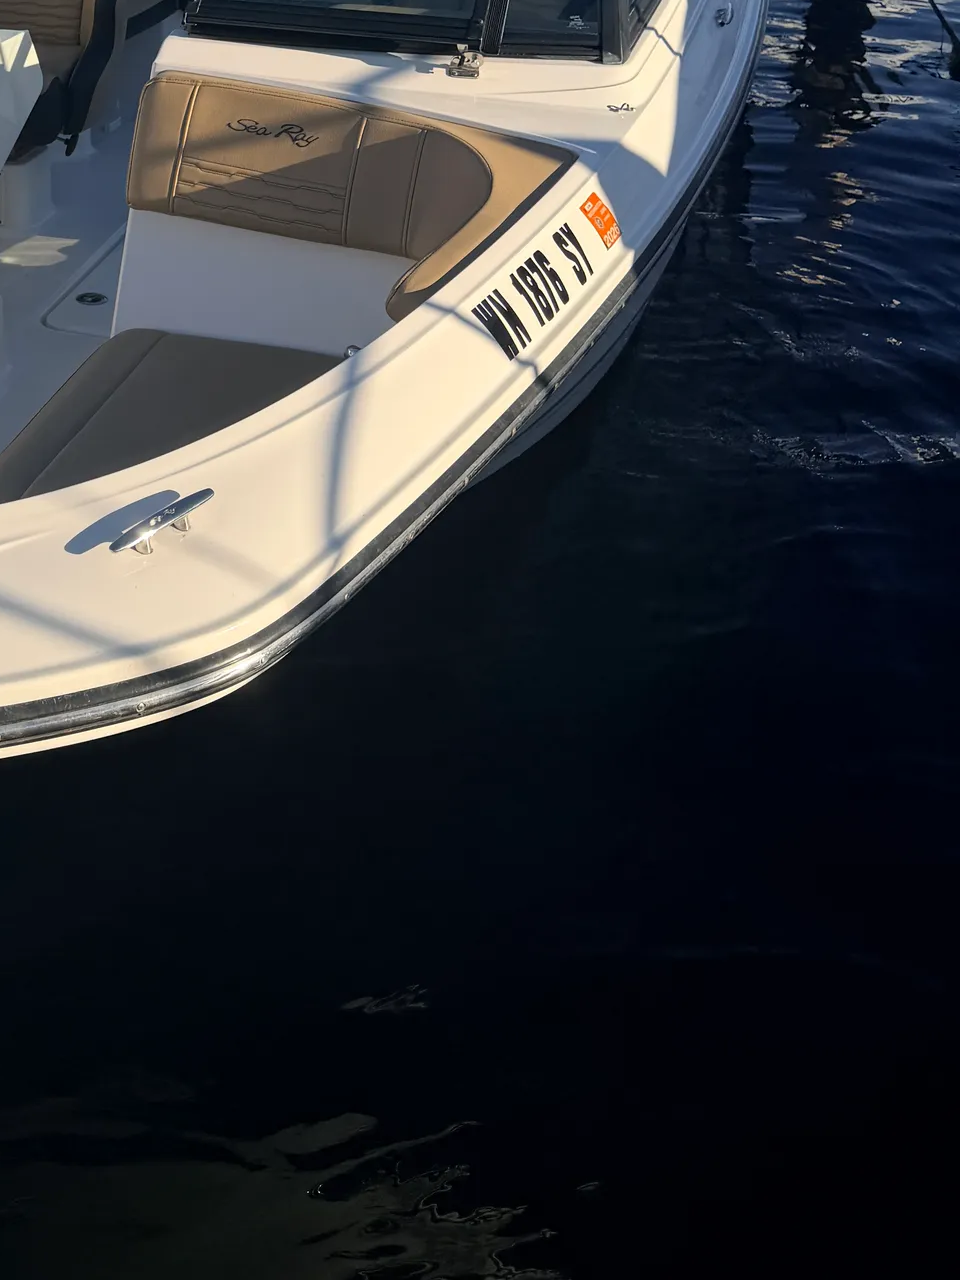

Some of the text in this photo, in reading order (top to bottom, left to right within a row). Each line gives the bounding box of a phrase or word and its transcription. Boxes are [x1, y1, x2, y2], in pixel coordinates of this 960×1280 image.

[226, 118, 320, 148] Sea Ray
[603, 222, 621, 249] 2026
[471, 222, 594, 361] WN 1876 SY
